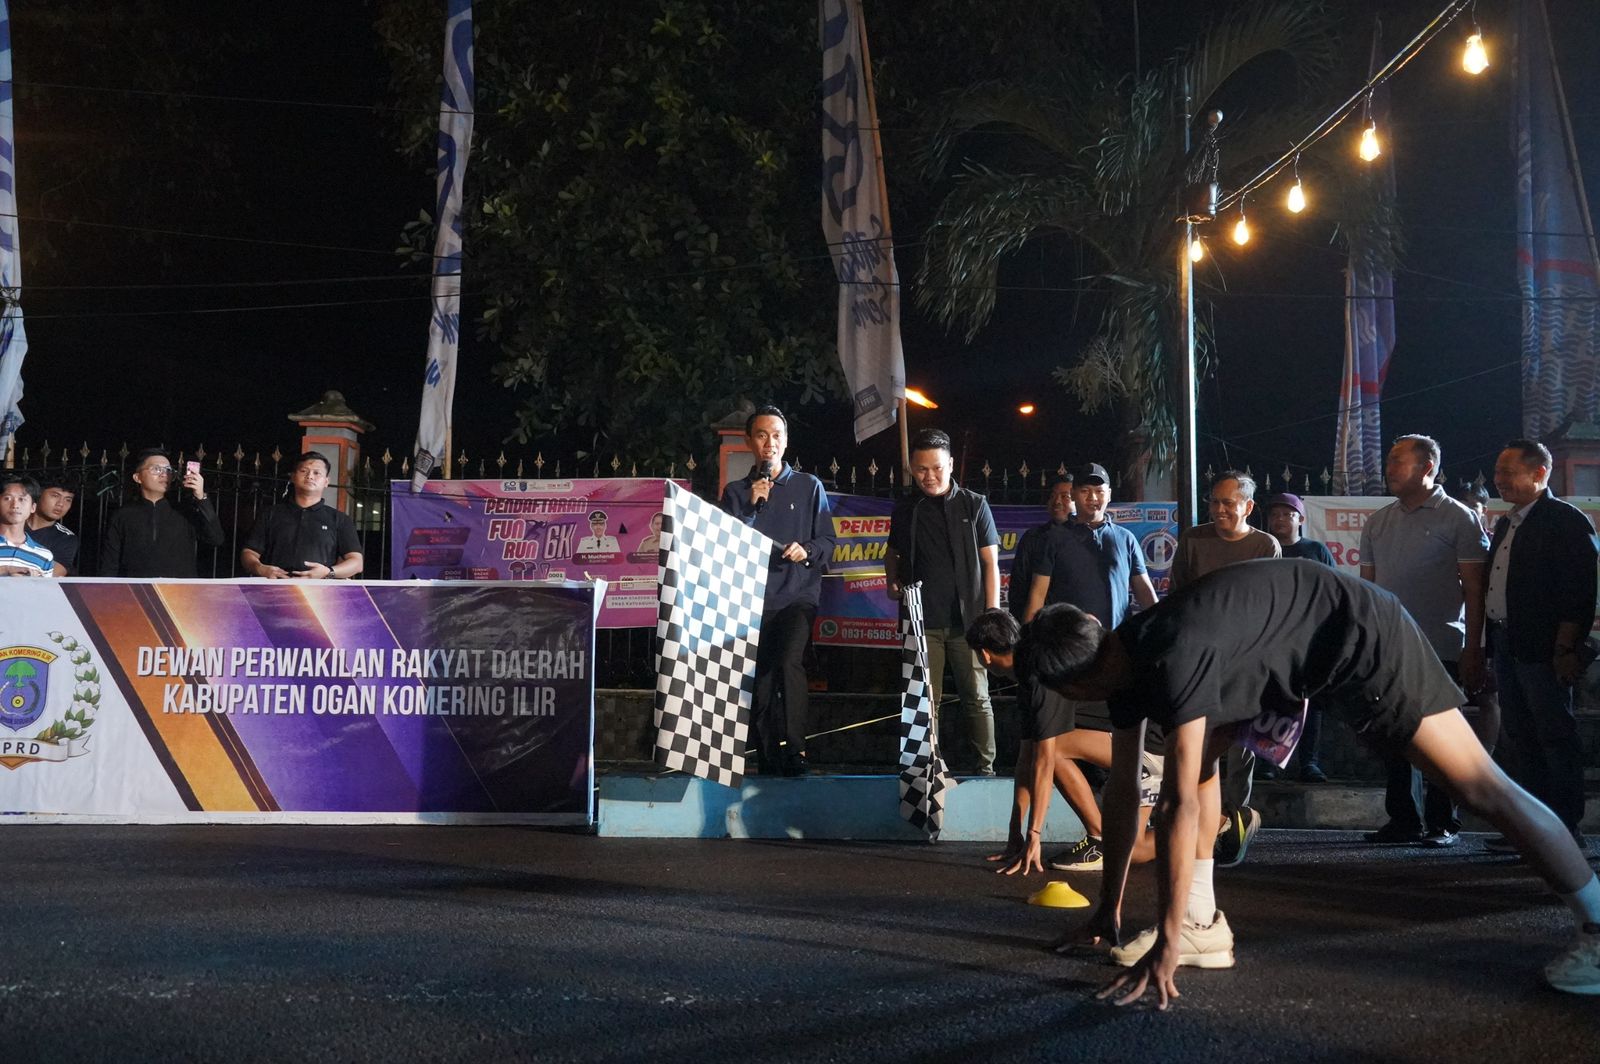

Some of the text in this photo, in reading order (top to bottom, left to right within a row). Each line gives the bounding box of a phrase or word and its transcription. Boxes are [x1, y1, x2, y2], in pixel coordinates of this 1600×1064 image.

[484, 497, 588, 515] PENDAFTARAN
[487, 519, 526, 541] FUN
[543, 522, 577, 560] 6K
[502, 540, 539, 560] RUN
[9, 649, 42, 657] KOMERING
[137, 646, 585, 680] DEWAN PERWAKILAN RAKYAT DAERAH
[163, 683, 556, 717] KABUPATEN OGAN KOMERING ILIR
